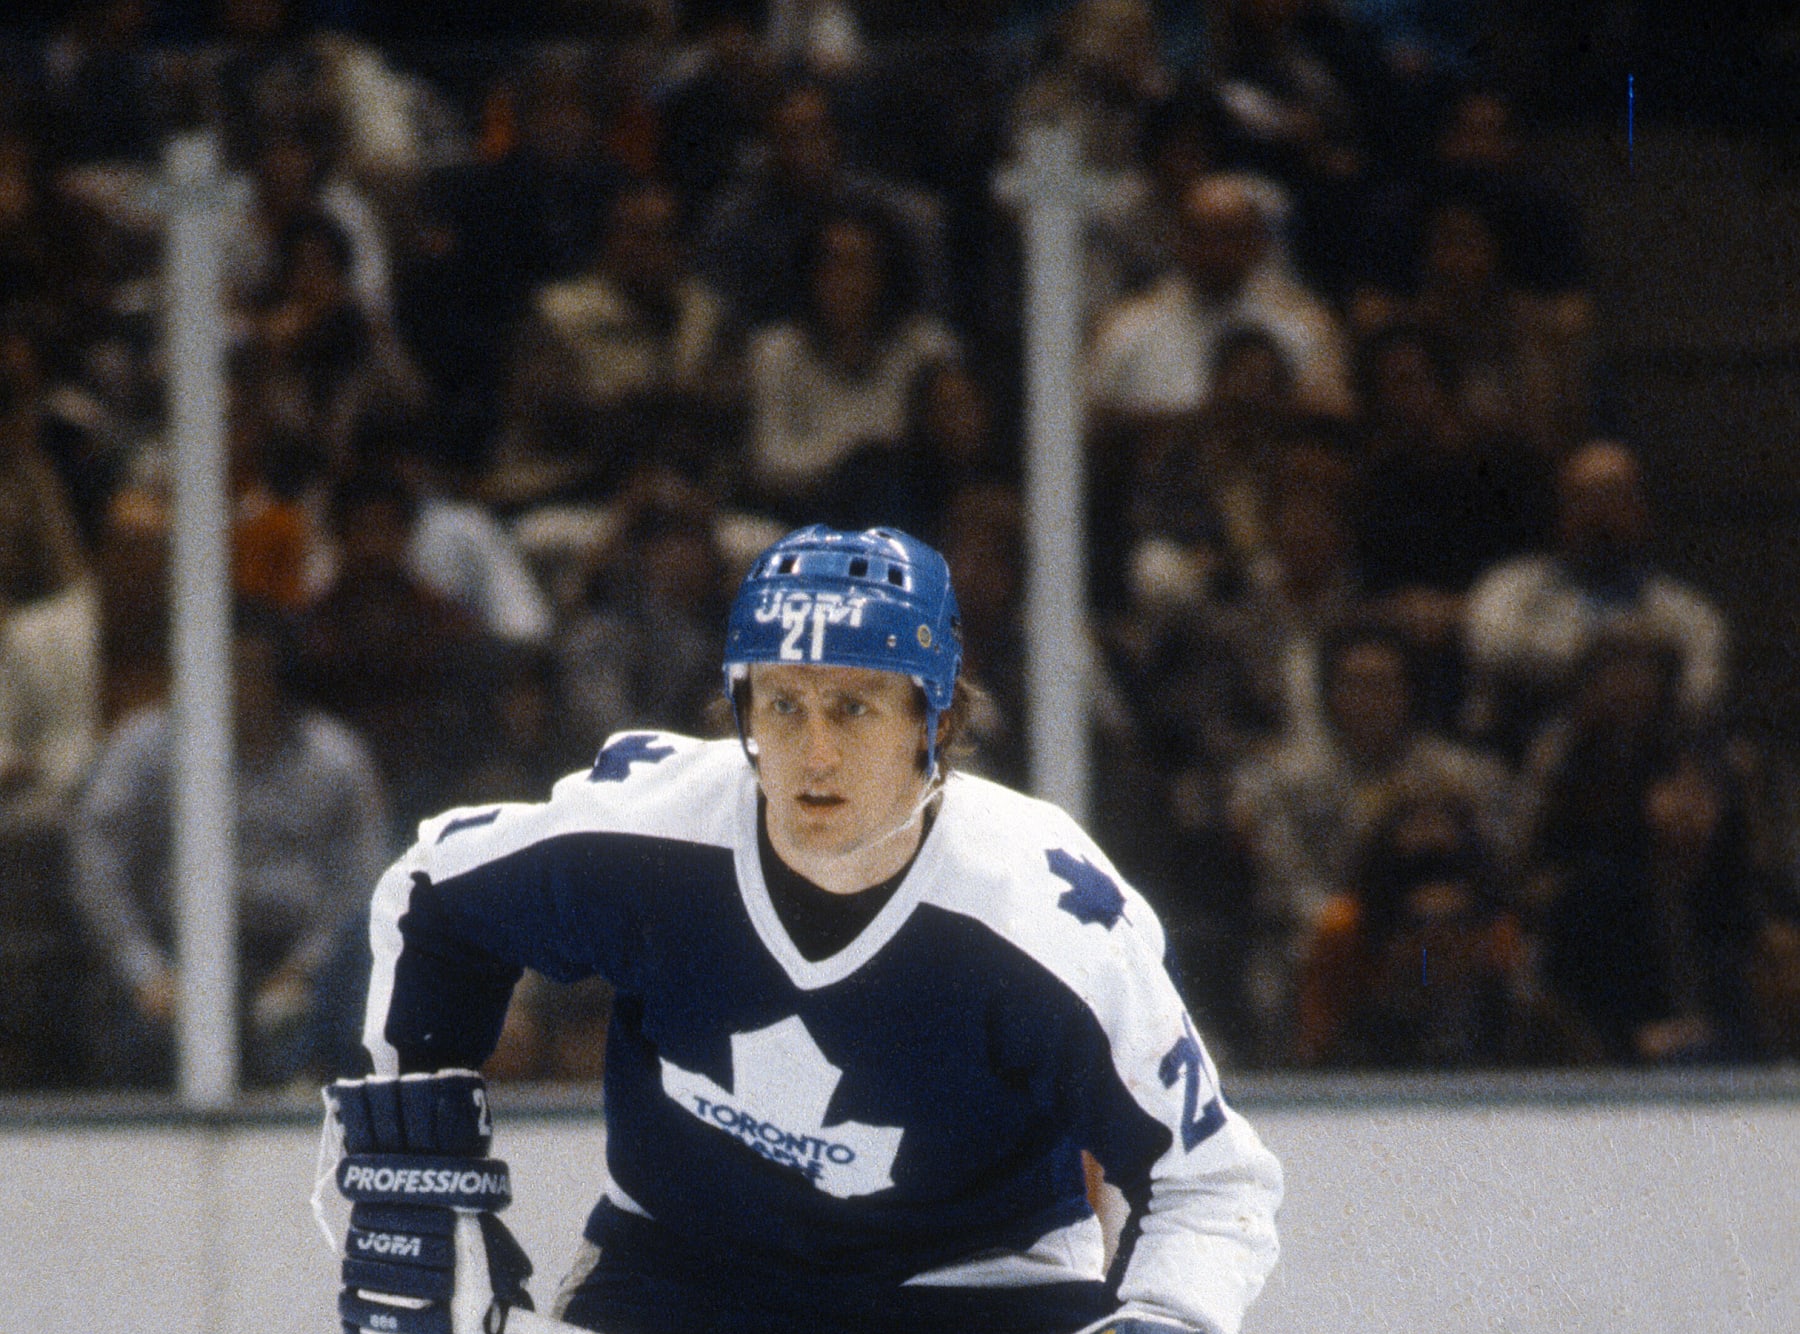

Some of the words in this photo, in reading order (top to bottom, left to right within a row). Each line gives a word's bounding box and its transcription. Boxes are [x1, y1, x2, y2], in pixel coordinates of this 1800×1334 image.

[780, 606, 827, 661] 21
[1158, 1011, 1228, 1155] 2
[694, 1095, 856, 1165] TORONTO
